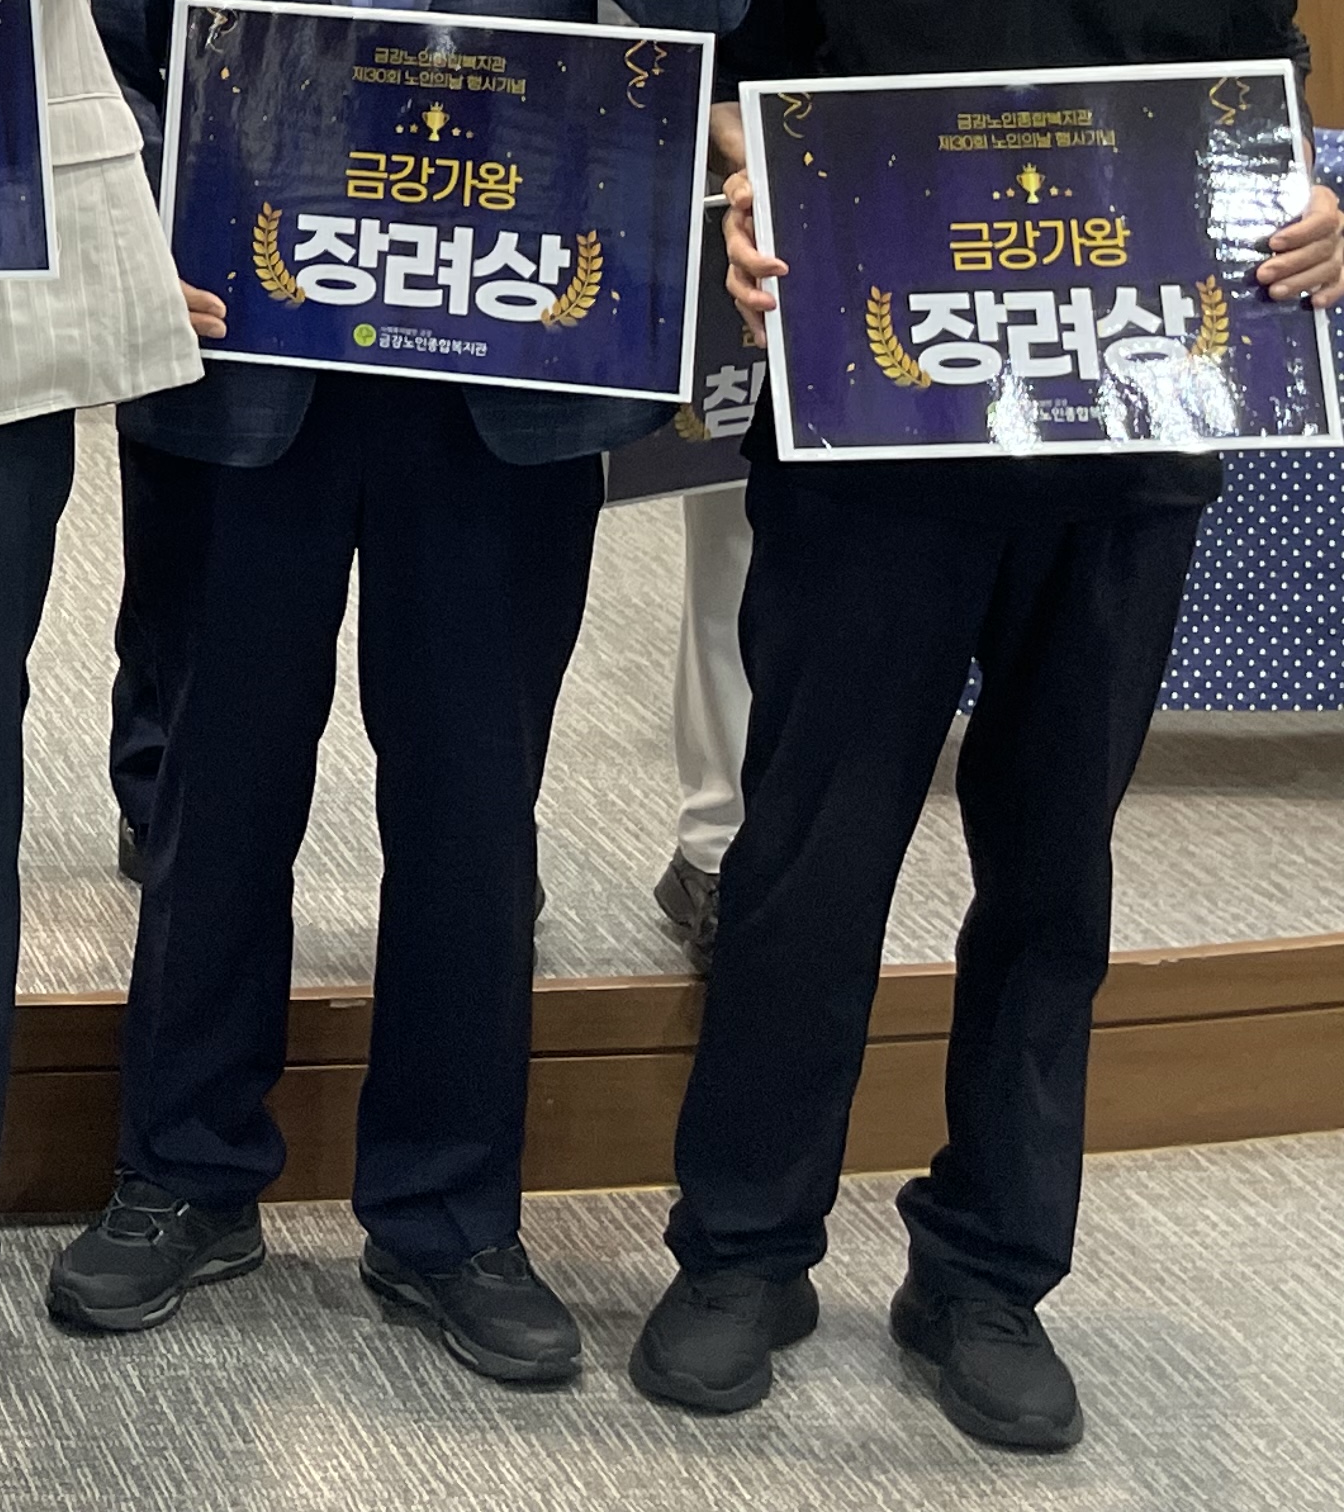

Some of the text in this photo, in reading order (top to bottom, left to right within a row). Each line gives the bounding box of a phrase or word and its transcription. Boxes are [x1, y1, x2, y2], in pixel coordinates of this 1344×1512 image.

[345, 152, 523, 211] 금강가왕
[293, 213, 571, 323] 장려상
[949, 217, 1131, 271] 금강가왕
[908, 284, 1197, 386] 장려상
